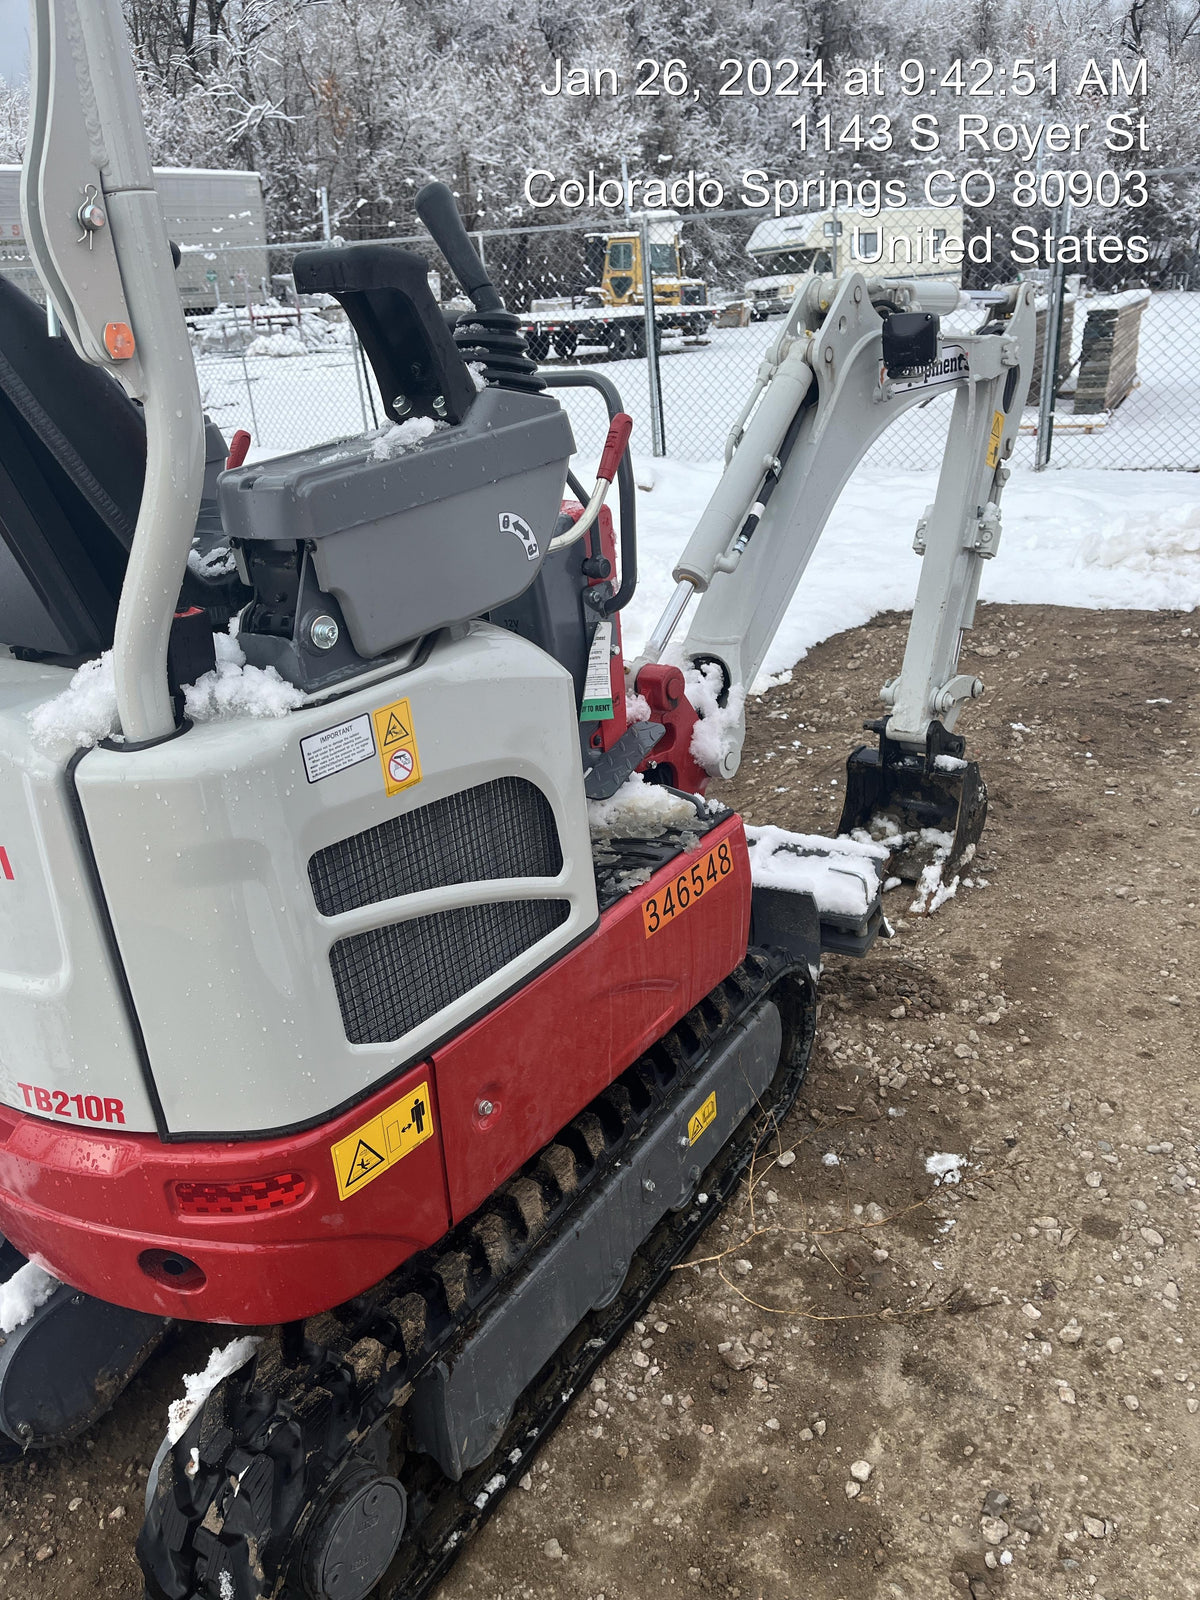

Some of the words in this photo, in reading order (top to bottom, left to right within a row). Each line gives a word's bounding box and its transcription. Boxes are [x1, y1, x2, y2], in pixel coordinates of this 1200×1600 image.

[595, 704, 610, 712] RENT
[320, 725, 353, 744] IMPORTANT
[646, 843, 731, 932] 346548
[17, 1082, 126, 1124] TB210R
